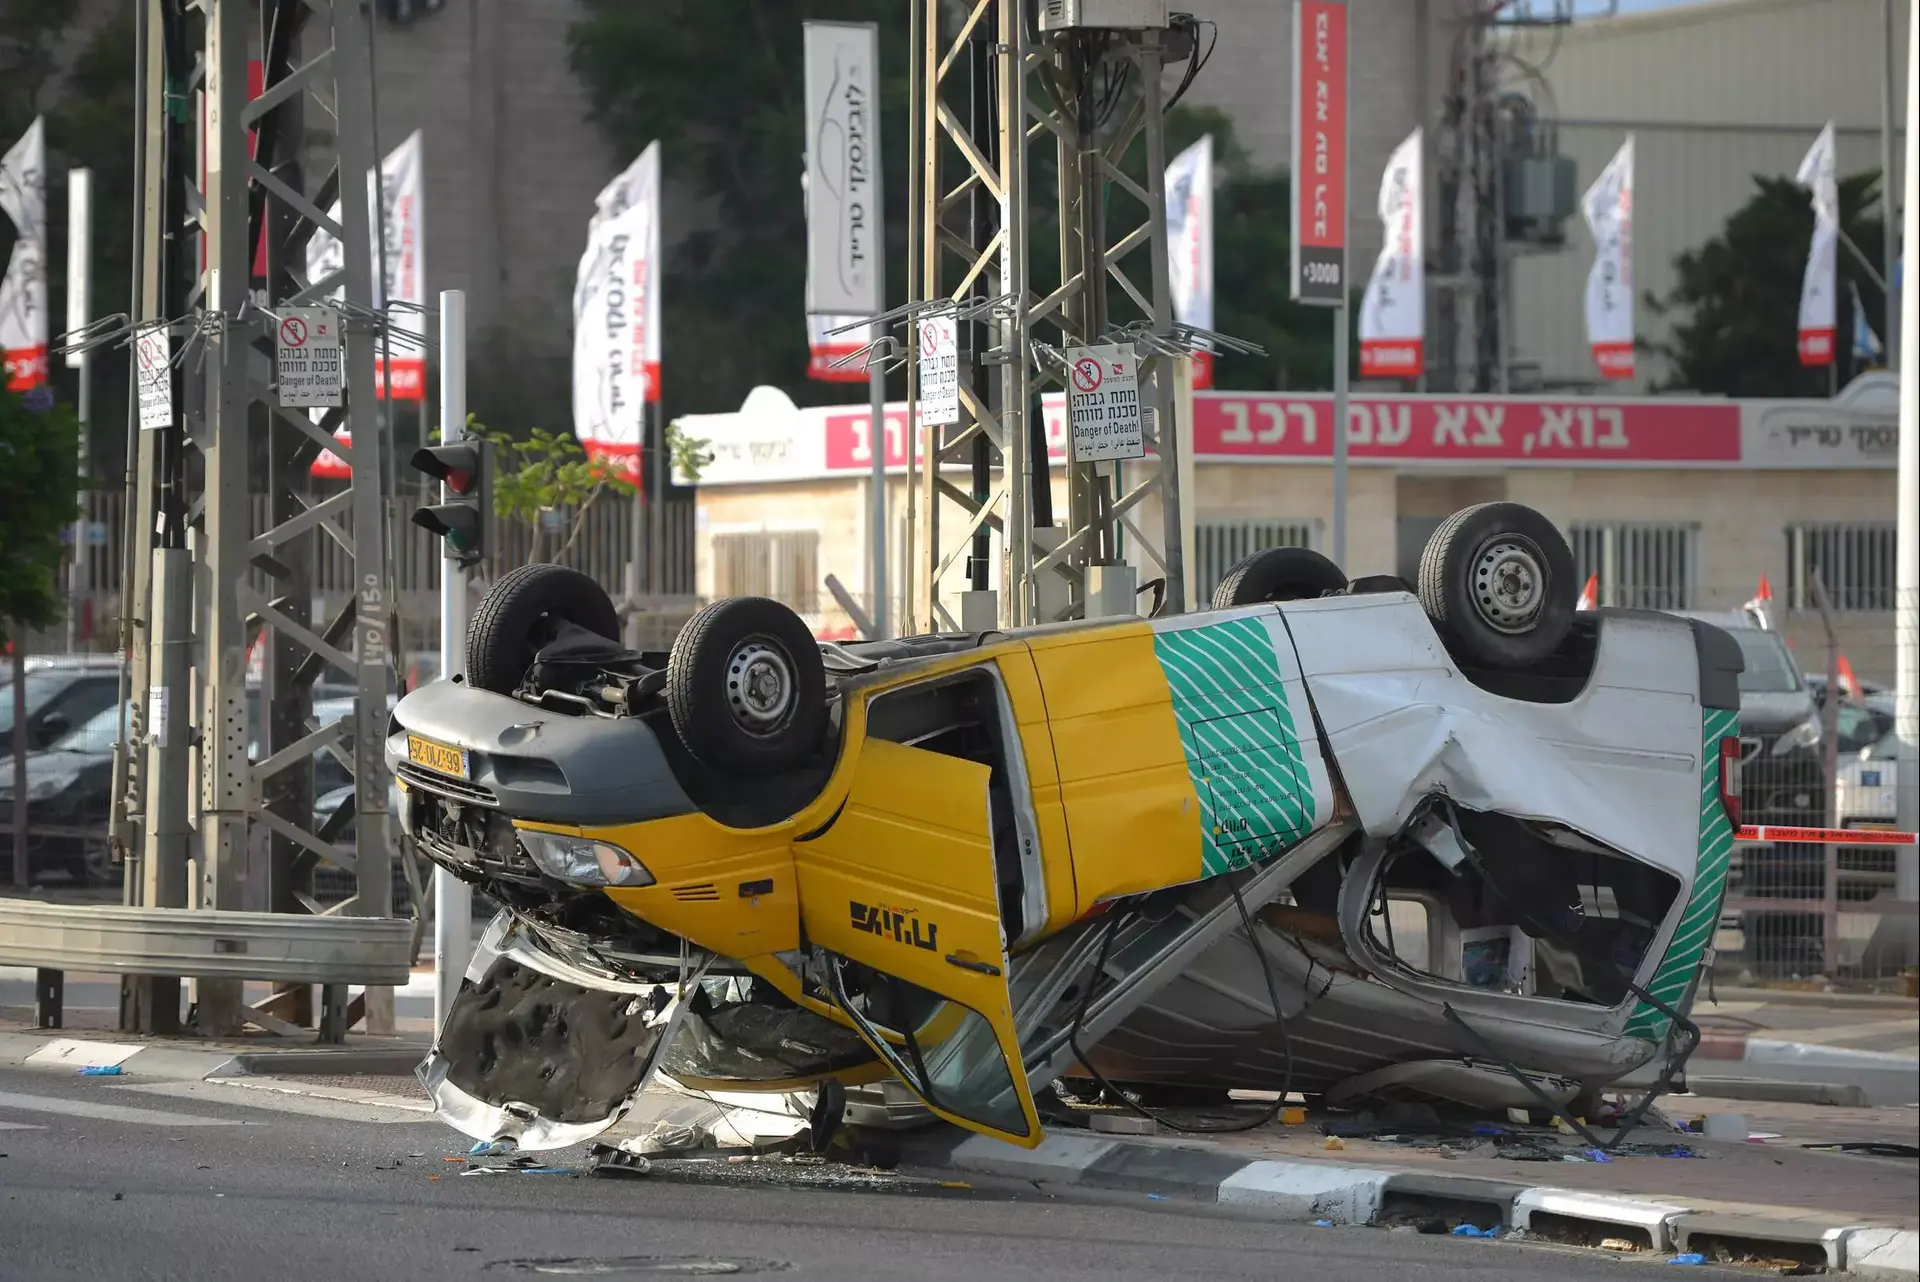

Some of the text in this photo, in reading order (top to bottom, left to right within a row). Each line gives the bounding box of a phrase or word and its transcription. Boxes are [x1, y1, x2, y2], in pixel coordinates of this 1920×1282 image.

[845, 84, 865, 268] לובינסקי טרייד
[280, 347, 337, 359] מתח גבוה!
[279, 361, 338, 372] סכנת מוות!
[280, 374, 339, 388] Danger of Death!
[1072, 389, 1136, 407] מתח גבוה!
[1072, 407, 1103, 423] מוות!
[1108, 404, 1137, 419] סכנת
[1074, 420, 1139, 439] Danger of Death!
[1219, 402, 1629, 455] בוא, צא עם רכב
[1785, 424, 1842, 447] טרייד
[357, 573, 386, 665] 140/150
[849, 901, 938, 952] מונית
